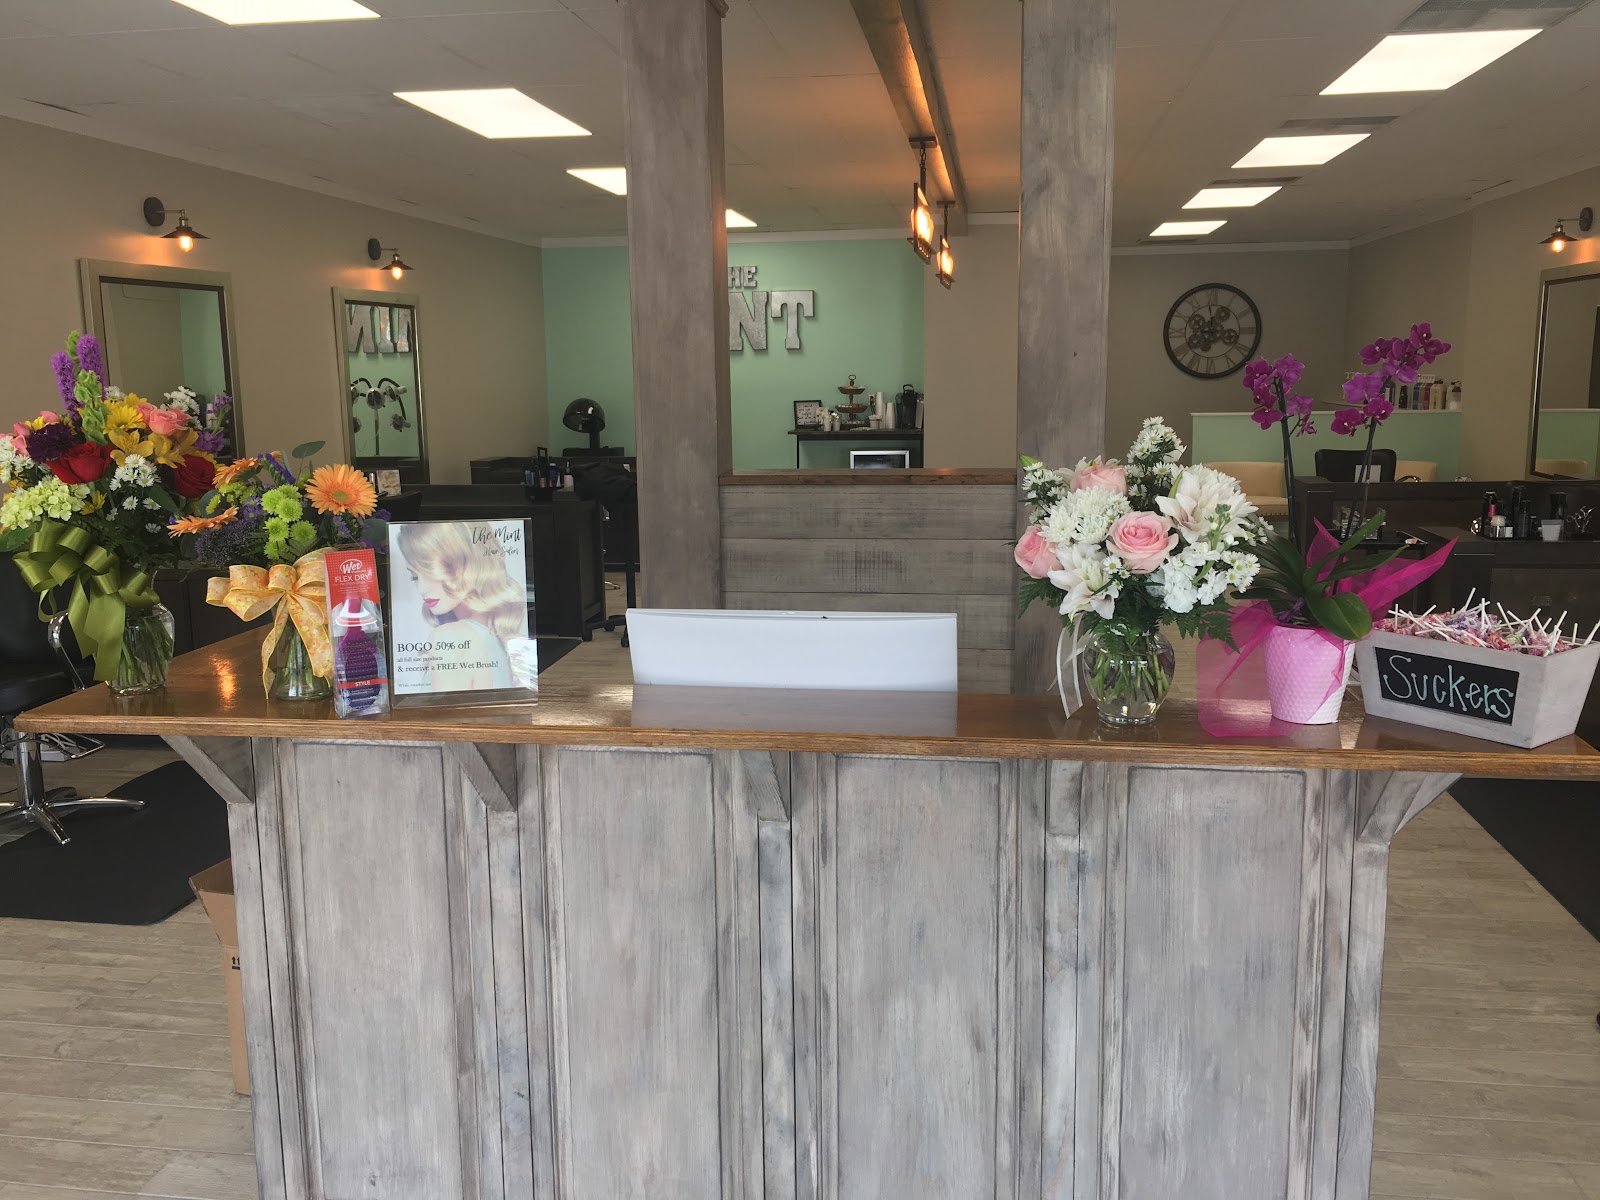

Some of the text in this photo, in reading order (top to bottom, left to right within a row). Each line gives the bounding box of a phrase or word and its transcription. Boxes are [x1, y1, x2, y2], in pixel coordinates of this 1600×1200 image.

[728, 266, 757, 288] HE
[728, 290, 814, 351] NT
[472, 525, 521, 545] The Mint
[342, 561, 361, 575] Wet
[334, 575, 354, 583] FLEX
[354, 573, 370, 581] DRY
[397, 640, 471, 653] BOGO 50% off
[405, 664, 429, 673] receive
[437, 662, 458, 671] FREE
[476, 660, 499, 669] Brush!
[1382, 654, 1514, 718] Suckers
